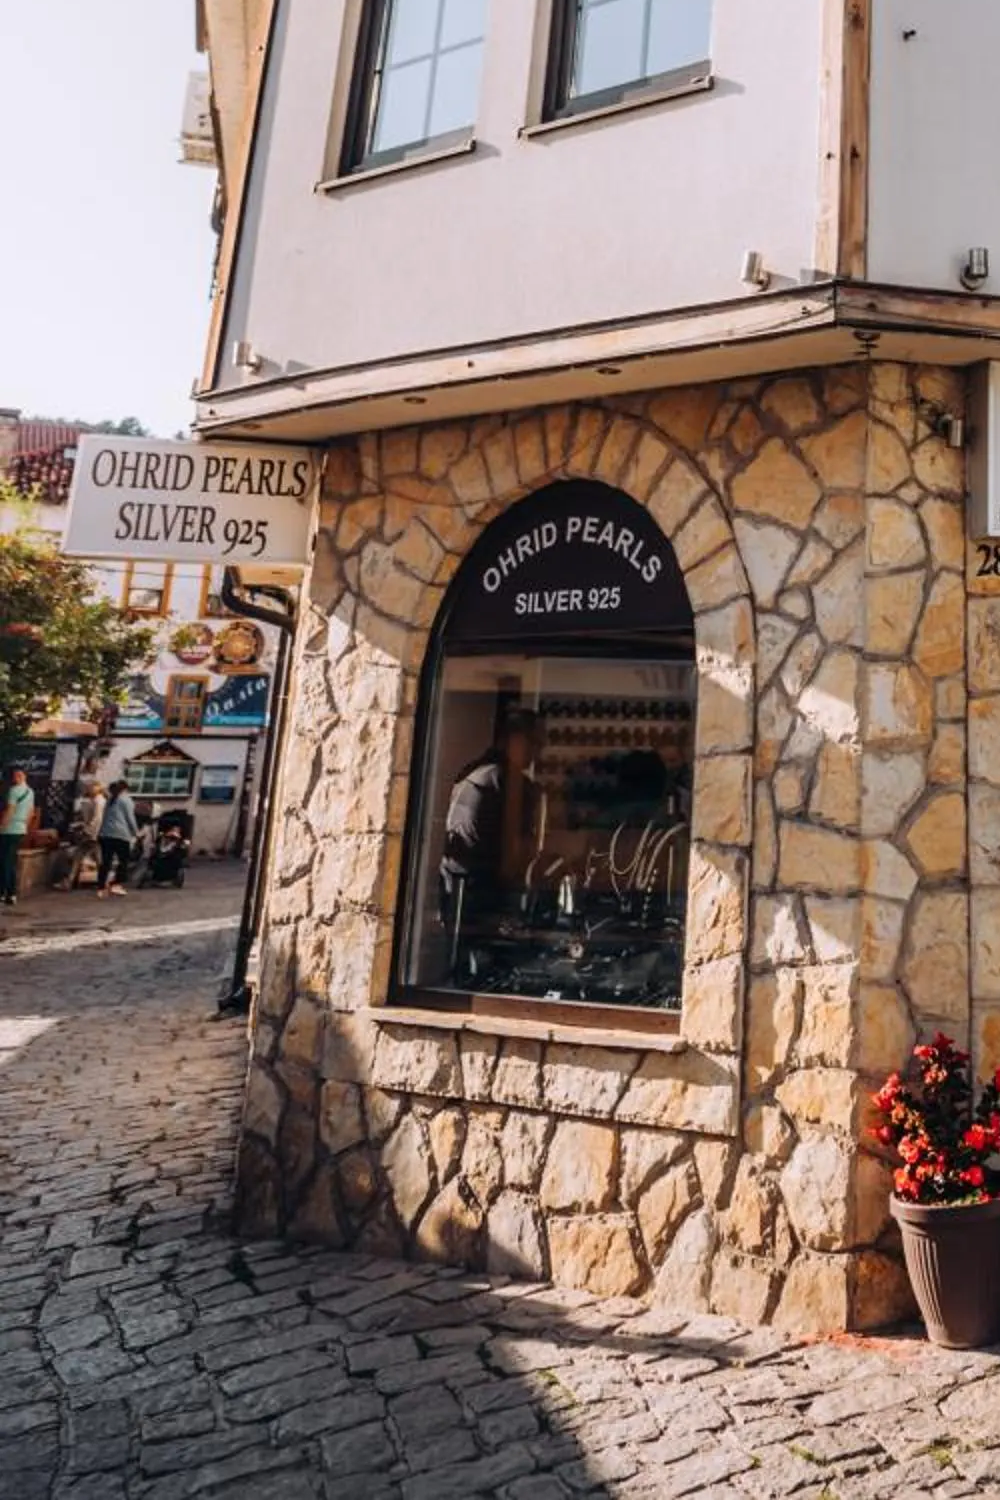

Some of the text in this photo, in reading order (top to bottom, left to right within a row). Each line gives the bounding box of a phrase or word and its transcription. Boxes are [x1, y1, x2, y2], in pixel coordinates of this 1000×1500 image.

[91, 448, 308, 498] OHRID PEARLS
[115, 501, 268, 556] SILVER 925
[482, 516, 662, 593] OHRID PEARLS
[515, 587, 621, 614] SILVER 925
